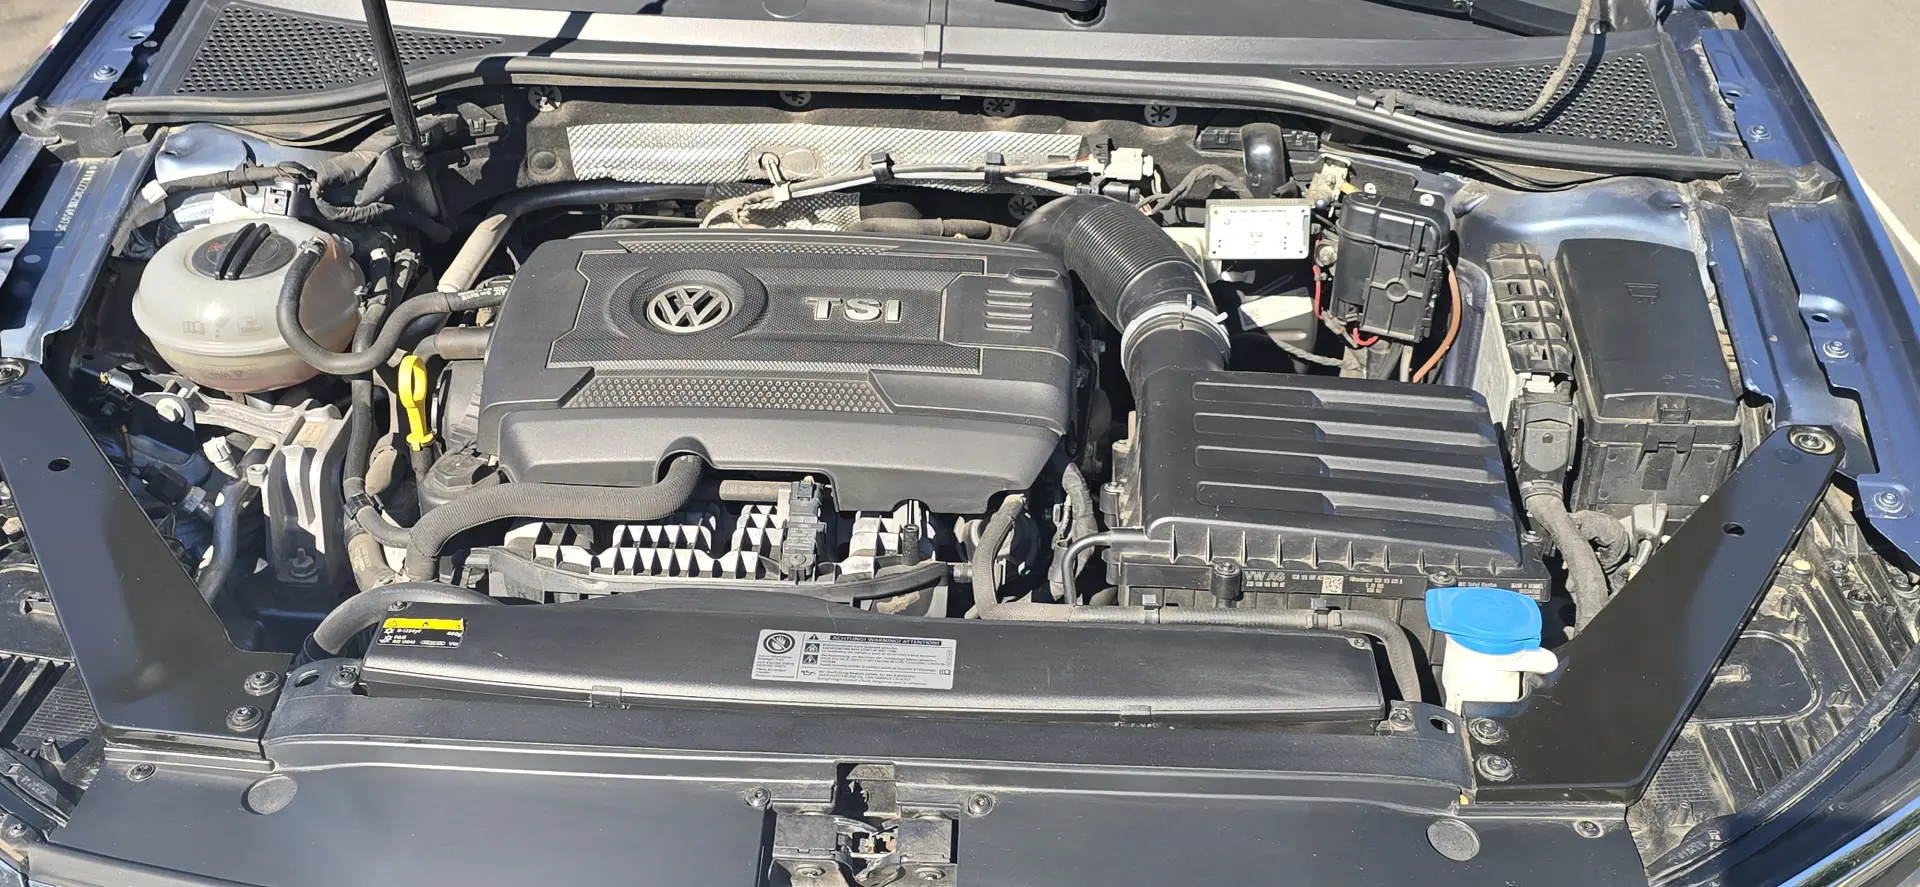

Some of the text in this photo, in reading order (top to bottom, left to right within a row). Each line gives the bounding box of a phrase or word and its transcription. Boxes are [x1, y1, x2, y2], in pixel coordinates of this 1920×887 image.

[806, 297, 901, 323] TSI
[1244, 571, 1266, 581] VW
[1266, 571, 1286, 582] AG
